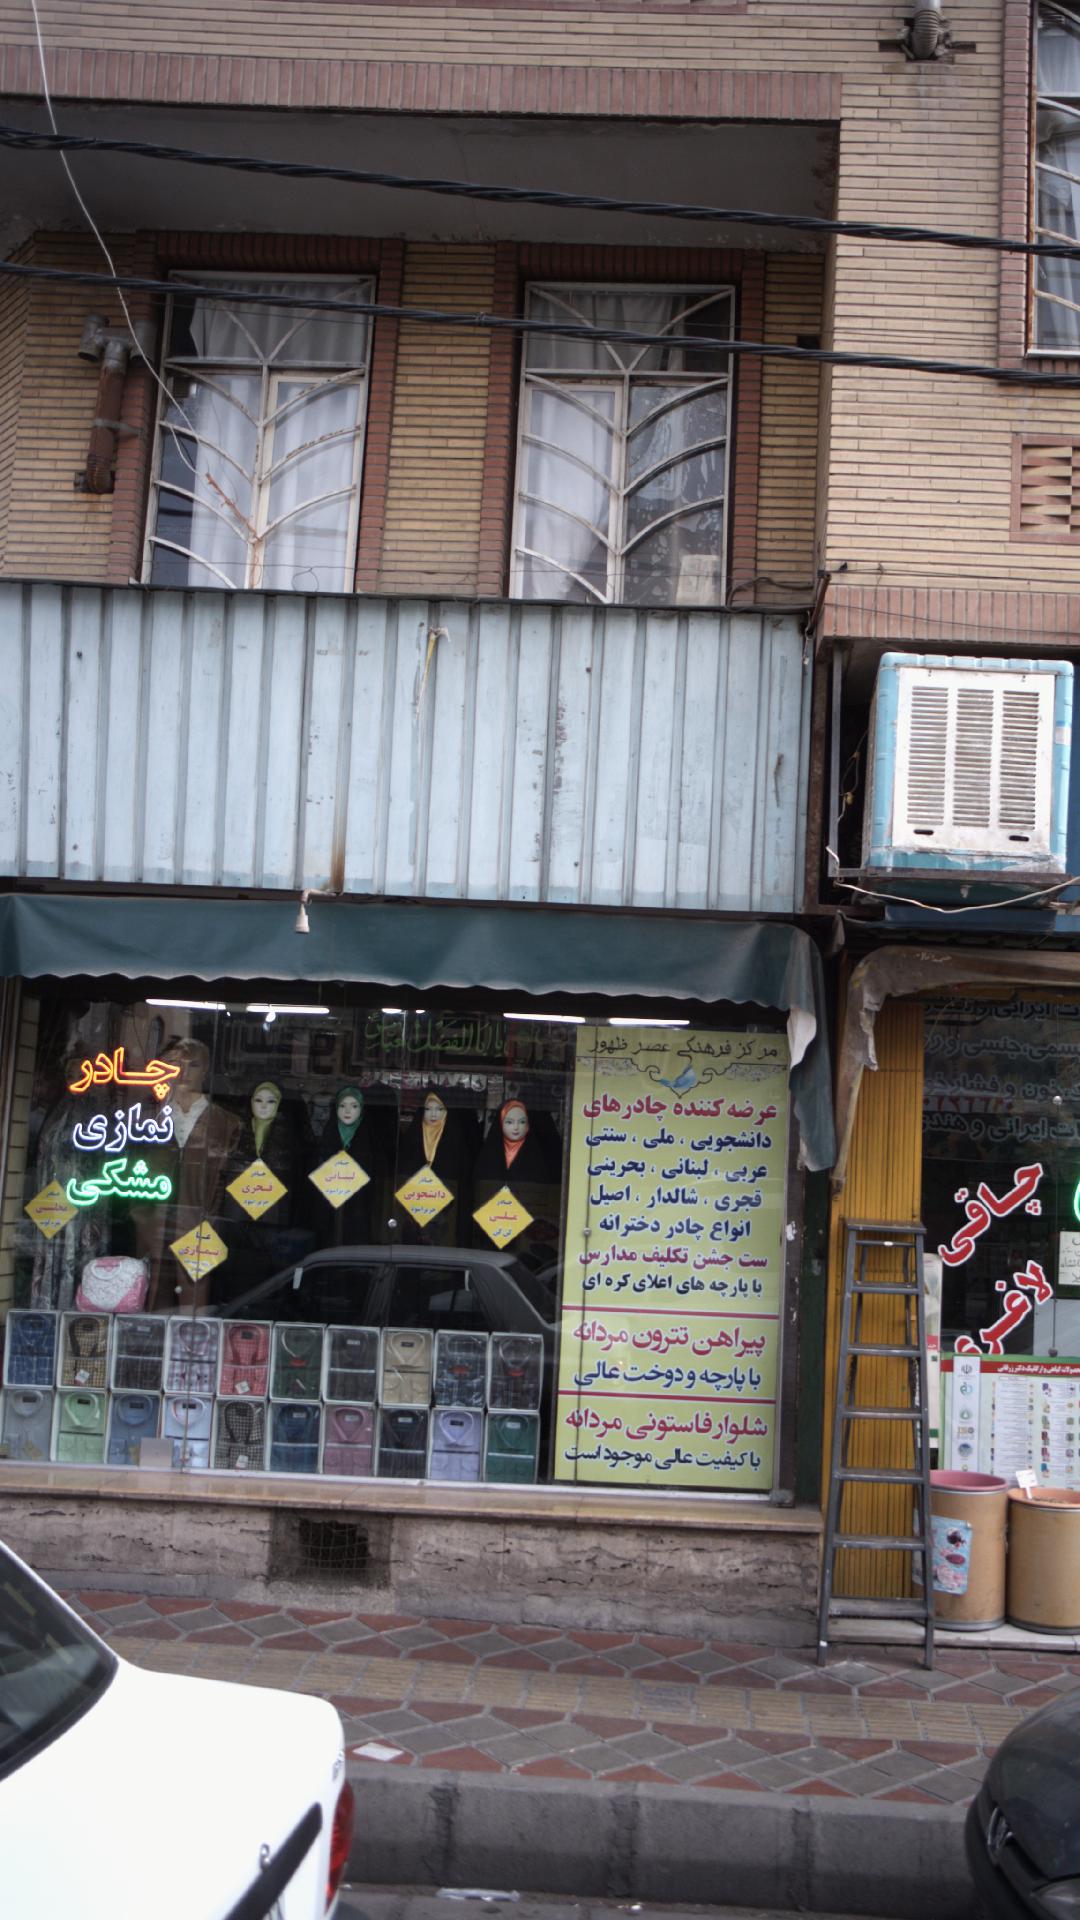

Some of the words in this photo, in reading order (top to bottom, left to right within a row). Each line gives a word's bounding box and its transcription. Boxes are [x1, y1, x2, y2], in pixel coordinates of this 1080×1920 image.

[589, 1038, 628, 1058] ظهور
[631, 1042, 671, 1055] عصر
[677, 1036, 731, 1062] فرهنگی
[736, 1040, 778, 1061] مرکز
[68, 1046, 181, 1100] چادر
[673, 1098, 724, 1117] کننده
[726, 1102, 778, 1126] عرضه
[73, 1103, 175, 1152] نمازی
[586, 1127, 627, 1147] سنتی
[970, 1120, 985, 1141] و
[989, 1117, 1048, 1141] ایرانی
[643, 1129, 675, 1149] ملی
[691, 1131, 772, 1152] دانشجویی
[588, 1158, 646, 1178] بحرینی
[661, 1159, 709, 1180] لبنانی
[725, 1164, 768, 1183] عربی
[65, 1157, 173, 1206] مشکی
[590, 1184, 631, 1207] اصیل
[647, 1186, 698, 1208] شالدار
[714, 1189, 763, 1212] قجری
[599, 1214, 661, 1237] دخترانه
[938, 1163, 1043, 1267] چاقی
[665, 1217, 705, 1240] چادر
[709, 1219, 751, 1242] انواع
[579, 1245, 637, 1268] مدارس
[642, 1246, 689, 1269] تکلیف
[693, 1249, 733, 1270] جشن
[738, 1252, 768, 1269] ست
[582, 1272, 601, 1292] ای
[606, 1273, 631, 1293] کره
[633, 1275, 672, 1293] اعلای
[676, 1275, 705, 1295] های
[709, 1278, 748, 1299] پارچه
[752, 1280, 762, 1298] با
[573, 1321, 629, 1351] مردانه
[632, 1326, 689, 1354] تترون
[691, 1327, 766, 1357] پیراهن
[574, 1360, 620, 1387] عالی
[623, 1363, 683, 1389] دوخت
[687, 1373, 696, 1388] و
[699, 1365, 746, 1392] پارچه
[749, 1368, 761, 1391] با
[565, 1408, 622, 1437] مردانه
[625, 1411, 712, 1441] فاستونی
[712, 1413, 768, 1444] شلوار
[565, 1443, 601, 1460] است
[603, 1445, 652, 1468] موجود
[655, 1448, 692, 1470] عالی
[696, 1450, 748, 1471] کیفیت
[749, 1453, 761, 1471] با
